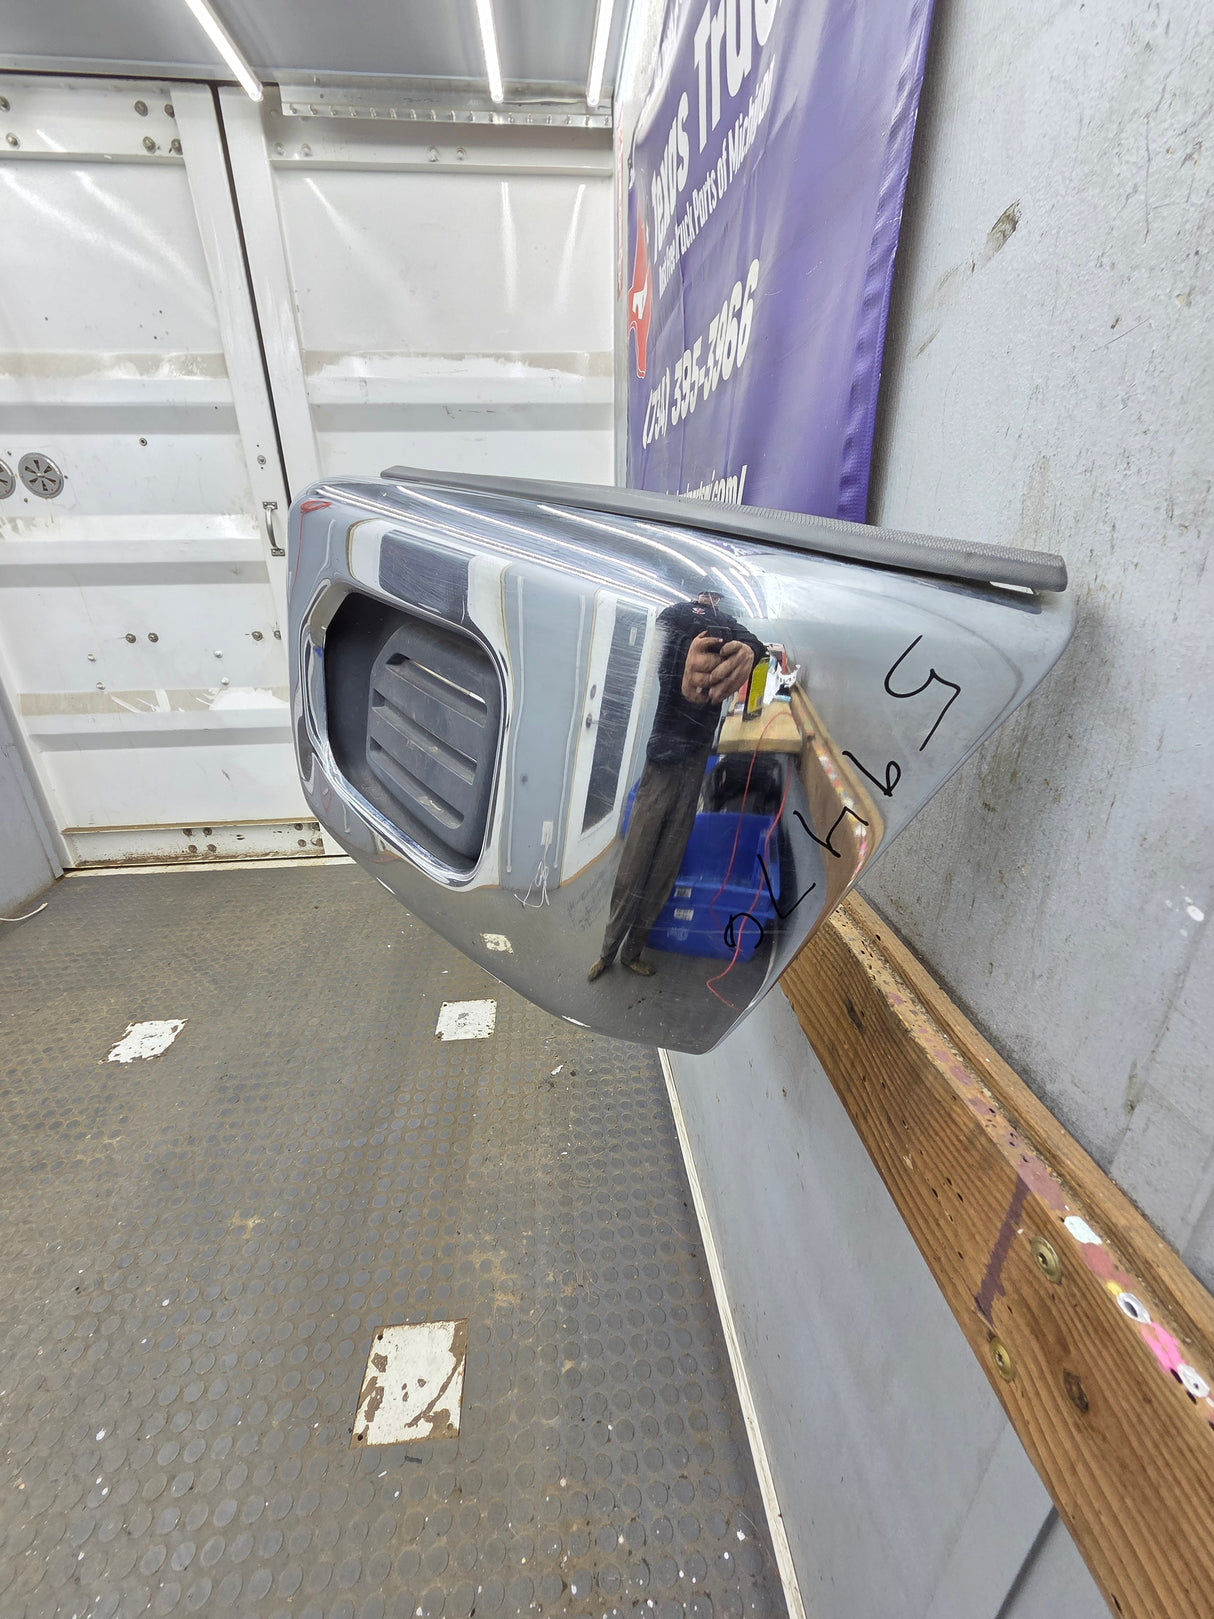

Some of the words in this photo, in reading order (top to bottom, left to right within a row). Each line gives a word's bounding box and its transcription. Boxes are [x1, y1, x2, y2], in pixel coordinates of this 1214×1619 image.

[651, 91, 689, 264] Texas
[692, 169, 717, 235] Parts
[717, 138, 728, 200] of
[671, 258, 760, 425] 395-3966
